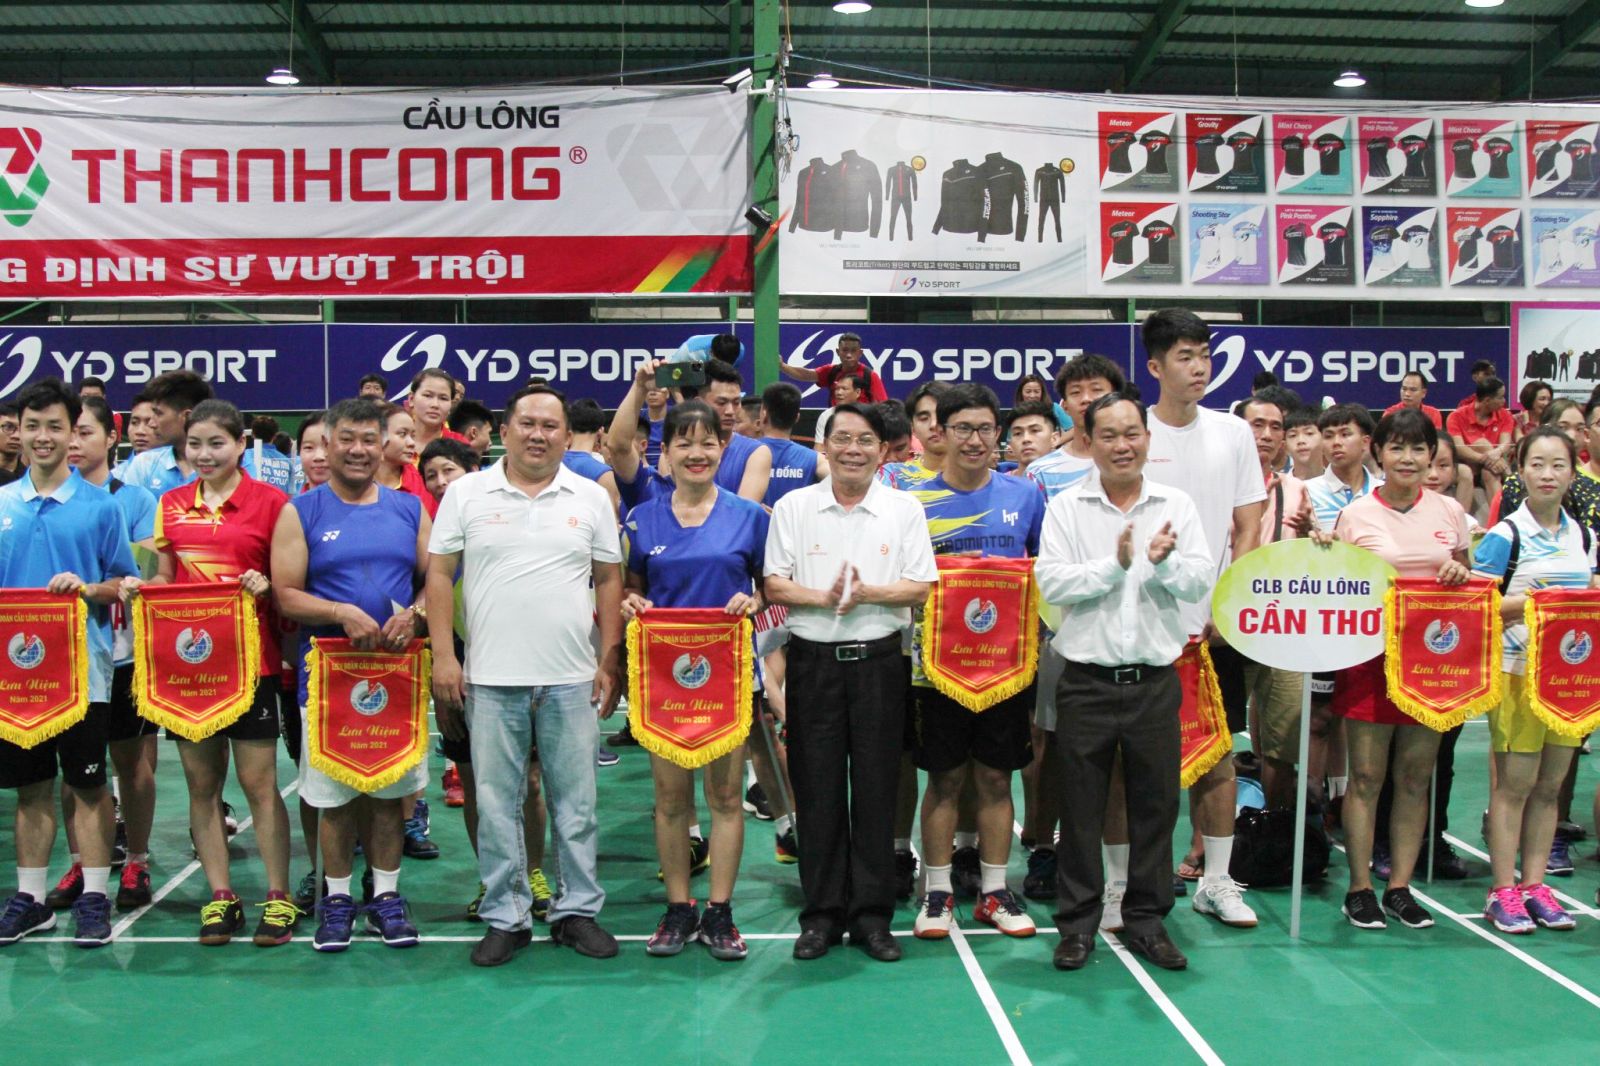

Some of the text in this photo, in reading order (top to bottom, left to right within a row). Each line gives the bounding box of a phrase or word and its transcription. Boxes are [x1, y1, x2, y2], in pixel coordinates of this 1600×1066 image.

[404, 97, 560, 130] CẦU LÔNG
[1109, 119, 1132, 127] Meteor
[1198, 121, 1219, 130] Gravity
[72, 146, 560, 204] THANHCONG
[1192, 210, 1217, 219] Shooting
[1293, 212, 1317, 220] Panther
[1370, 213, 1398, 222] Sapphire
[1533, 216, 1557, 224] Shooting
[44, 256, 165, 288] ĐỊNH
[185, 254, 256, 287] SỰ
[269, 253, 396, 287] VƯỢT
[412, 249, 524, 285] TRỘI
[51, 349, 276, 384] YD SPORT
[456, 349, 519, 382] YD
[862, 348, 1083, 381] YD SPORT
[1254, 351, 1464, 383] YD SPORT
[944, 535, 1015, 552] ADMINTON
[1252, 575, 1370, 595] CLB CẦU LÔNG
[1238, 600, 1383, 636] CẦN THƠ
[978, 659, 995, 667] 2021
[180, 689, 197, 697] Năm
[10, 695, 47, 704] Năm 2021
[693, 715, 711, 723] 2021
[1180, 720, 1199, 732] iệm
[350, 741, 387, 749] Năm 2021
